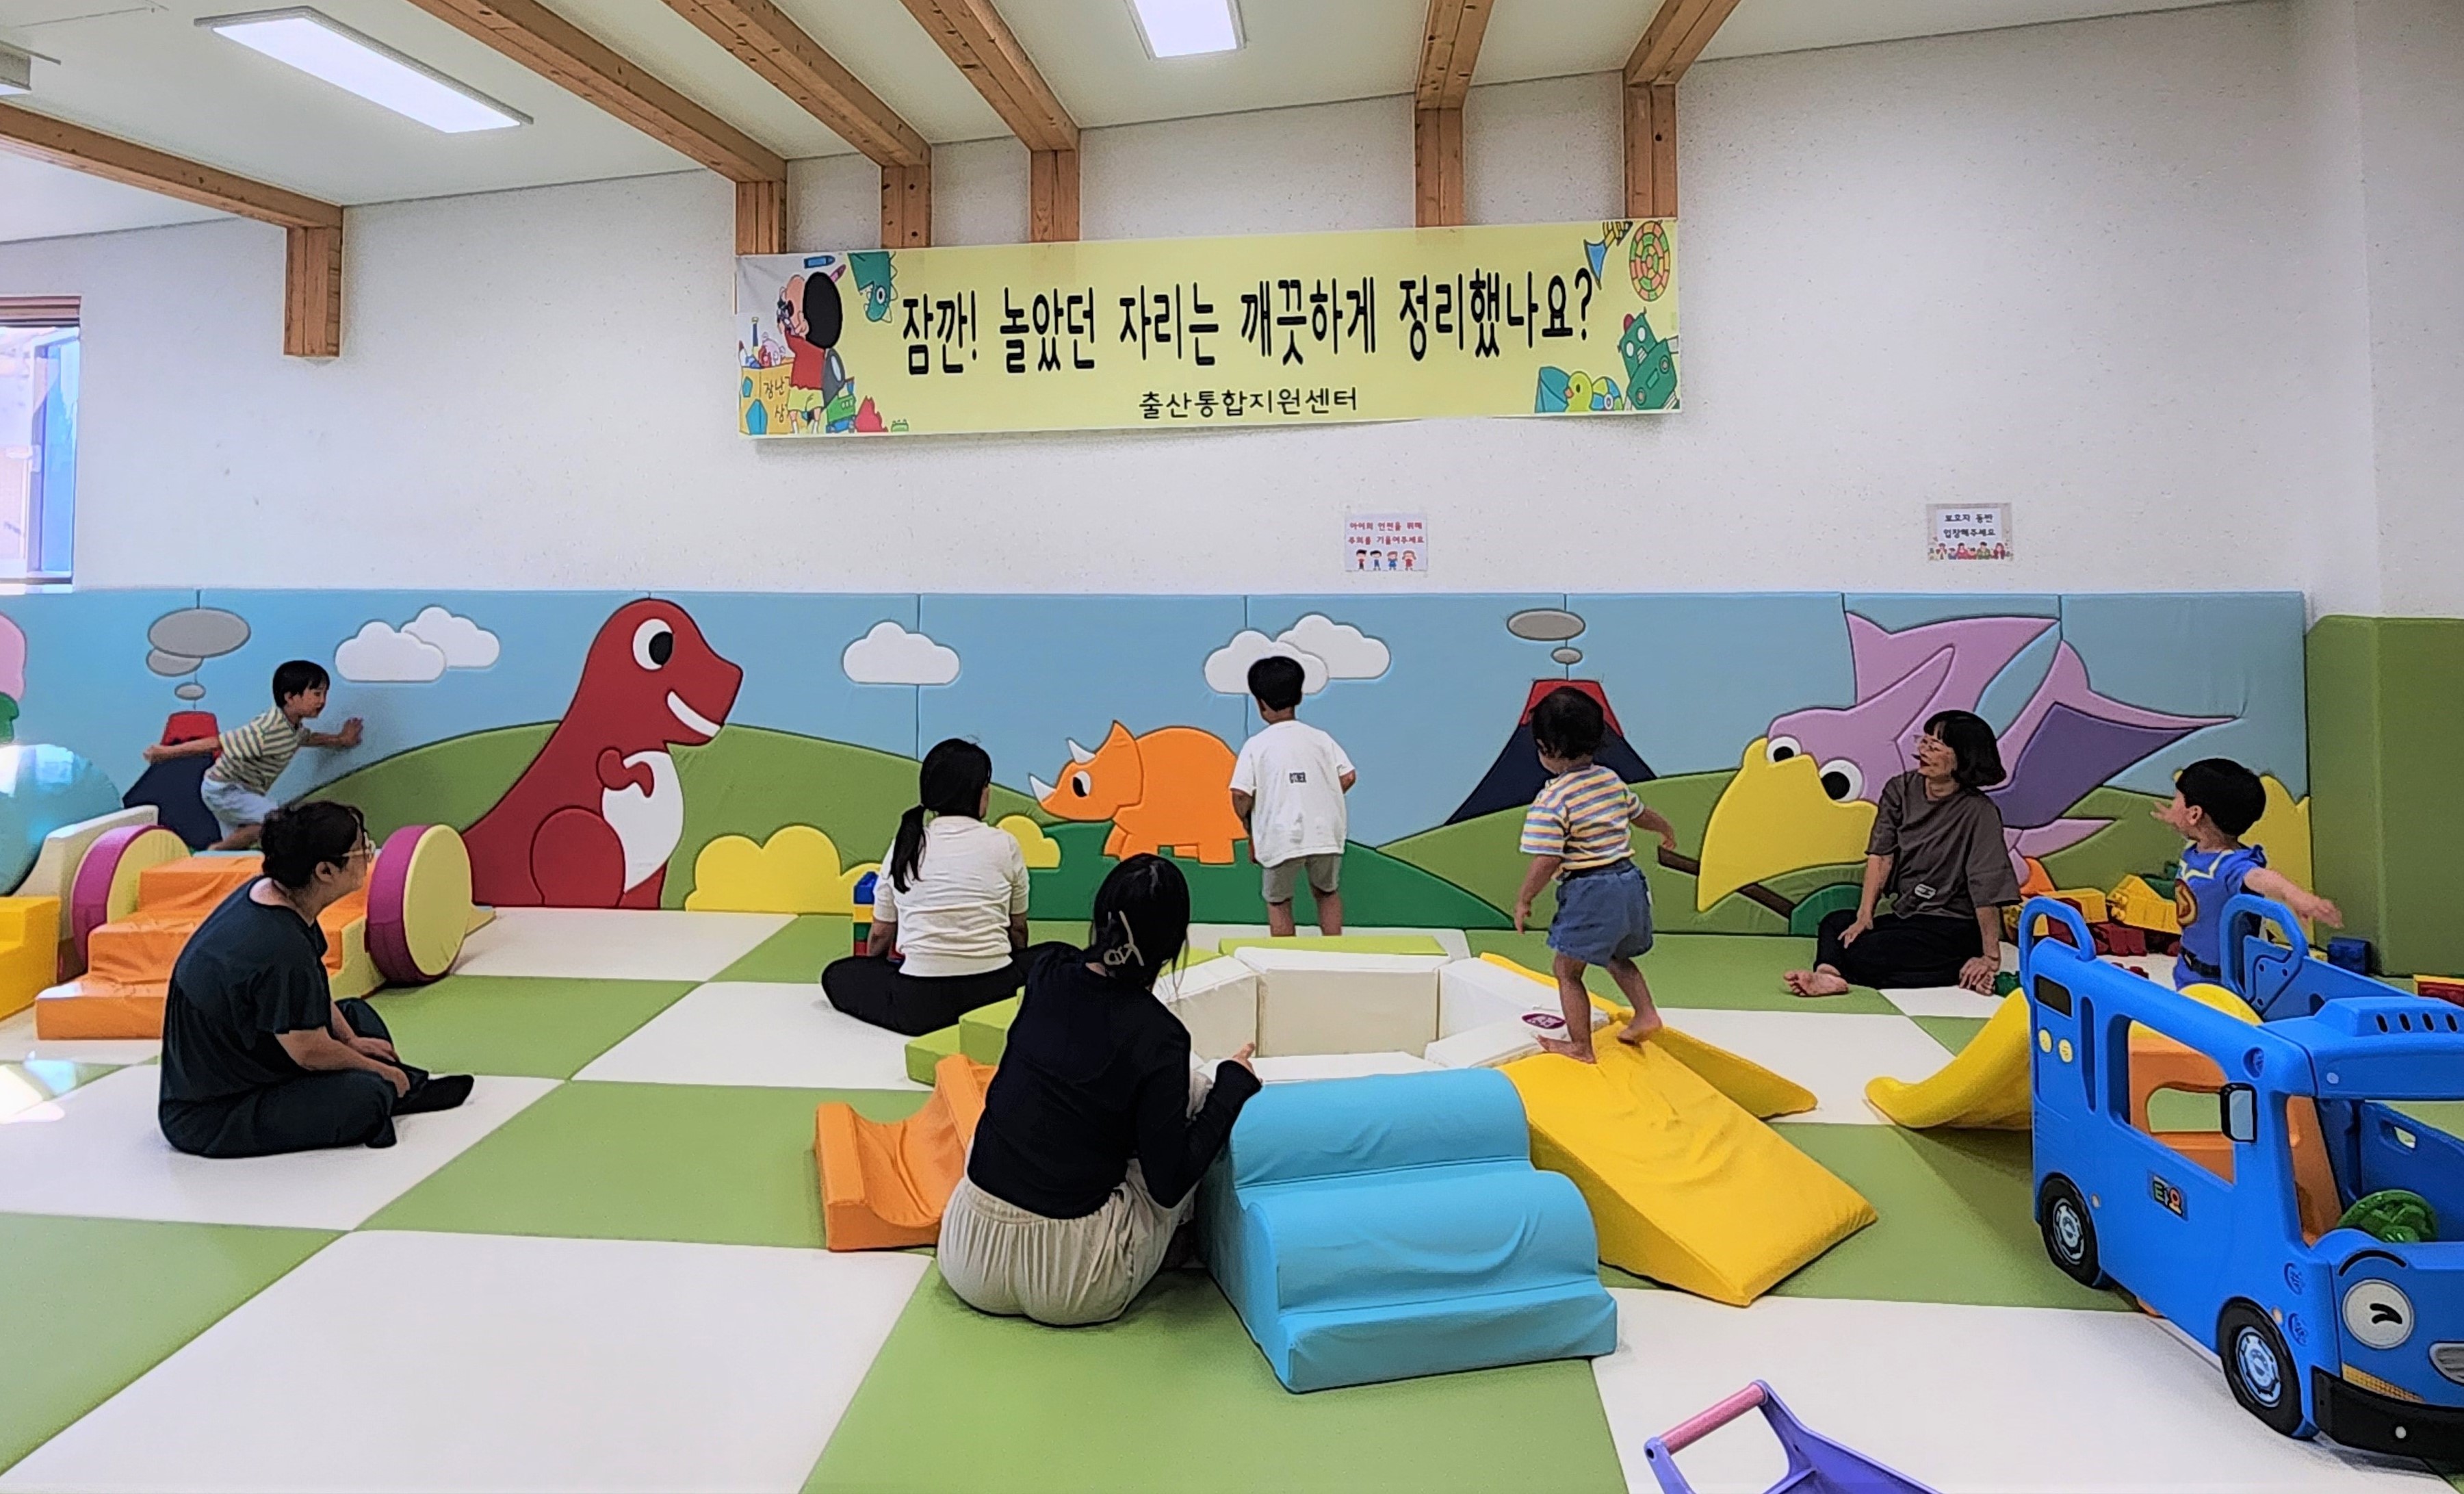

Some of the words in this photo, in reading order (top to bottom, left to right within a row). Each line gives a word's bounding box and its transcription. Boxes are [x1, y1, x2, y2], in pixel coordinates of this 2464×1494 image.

[903, 290, 977, 375] 잠깐!
[1000, 287, 1095, 374] 놀았던
[1119, 282, 1219, 366] 자리는
[1241, 276, 1375, 365] 깨끗하게
[1399, 268, 1592, 361] 정리했나요?
[763, 376, 791, 400] 장난
[1139, 387, 1356, 420] 출산통합지원센터
